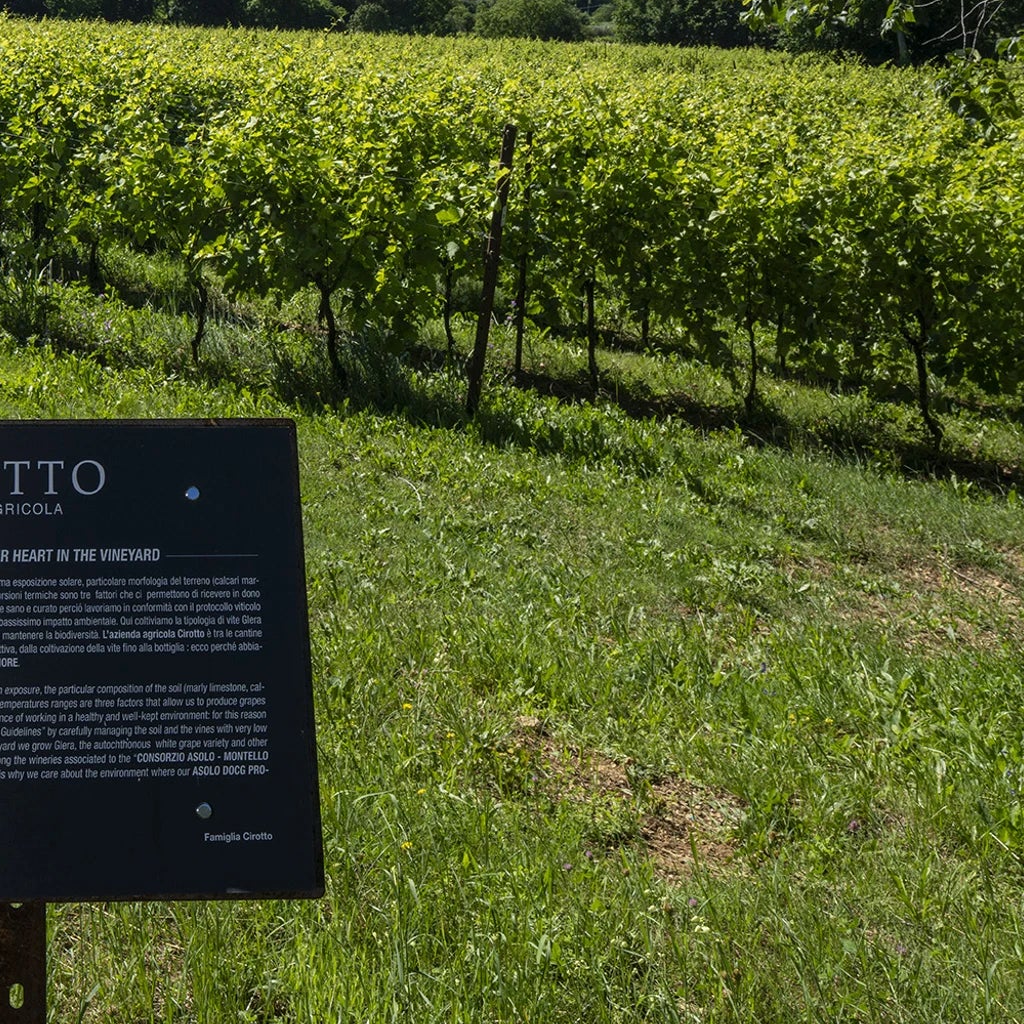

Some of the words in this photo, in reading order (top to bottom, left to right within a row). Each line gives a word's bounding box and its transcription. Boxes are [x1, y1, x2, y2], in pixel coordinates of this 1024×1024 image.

[12, 548, 54, 563] HEART
[56, 548, 70, 562] IN
[72, 548, 97, 562] THE
[99, 548, 161, 562] VINEYARD
[12, 575, 57, 588] esposizione
[85, 575, 126, 588] particolare
[127, 575, 168, 588] morfologia
[183, 574, 210, 585] terreno
[24, 589, 58, 599] termiche
[95, 588, 117, 599] fattori
[146, 588, 190, 601] permettono
[200, 587, 231, 598] ricevere
[32, 602, 57, 613] curato
[84, 601, 122, 612] lavoriamo
[195, 600, 233, 614] protocollo
[233, 600, 261, 611] viticolo
[43, 615, 72, 628] impatto
[134, 614, 173, 625] coltiviamo
[183, 614, 215, 627] tipologia
[2, 629, 43, 639] mantenere
[142, 628, 175, 641] agricola
[177, 628, 205, 638] Cirotto
[234, 627, 262, 638] cantine
[39, 641, 84, 653] coltivazione
[154, 641, 184, 654] bottiglia
[58, 682, 95, 696] particular
[96, 682, 144, 695] composition
[50, 699, 78, 710] ranges
[116, 696, 144, 707] factors
[205, 695, 238, 708] produce
[238, 697, 266, 708] grapes
[24, 710, 57, 724] working
[74, 710, 104, 723] healthy
[240, 711, 266, 719] reason
[58, 723, 92, 737] carefully
[93, 723, 133, 737] managing
[93, 737, 151, 749] autochthonous
[202, 736, 229, 750] variety
[28, 753, 63, 763] wineries
[64, 752, 106, 763] associated
[187, 751, 215, 762] ASOLO
[223, 751, 268, 761] MONTELLO
[99, 766, 149, 777] environment
[192, 765, 220, 776] ASOLO
[222, 765, 246, 776] DOCG
[247, 765, 269, 776] PRO-
[204, 831, 241, 844] Famiglia
[242, 831, 273, 841] Cirotto
